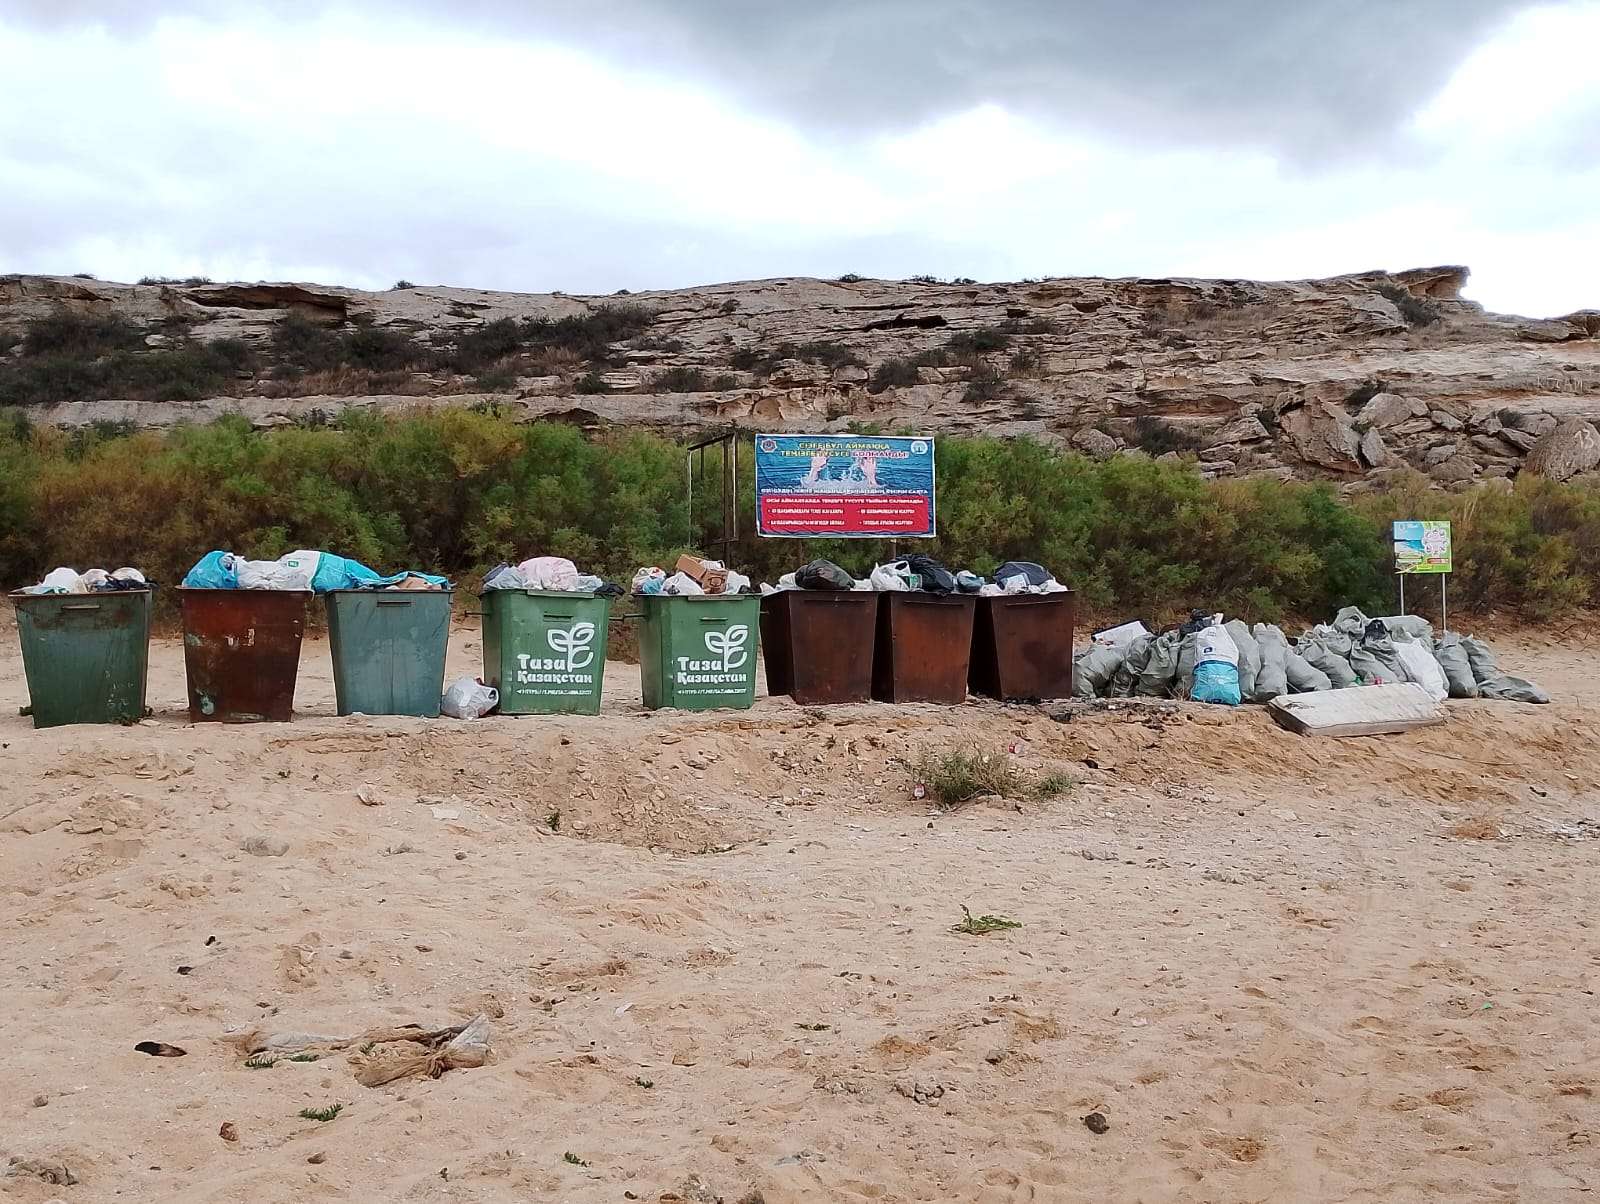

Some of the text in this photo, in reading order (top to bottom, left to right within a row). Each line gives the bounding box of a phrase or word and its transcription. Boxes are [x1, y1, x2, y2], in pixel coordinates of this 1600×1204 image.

[517, 653, 566, 670] Таза
[677, 656, 722, 671] Таза
[517, 670, 593, 684] Қазақстан
[677, 671, 747, 685] Қазақстан
